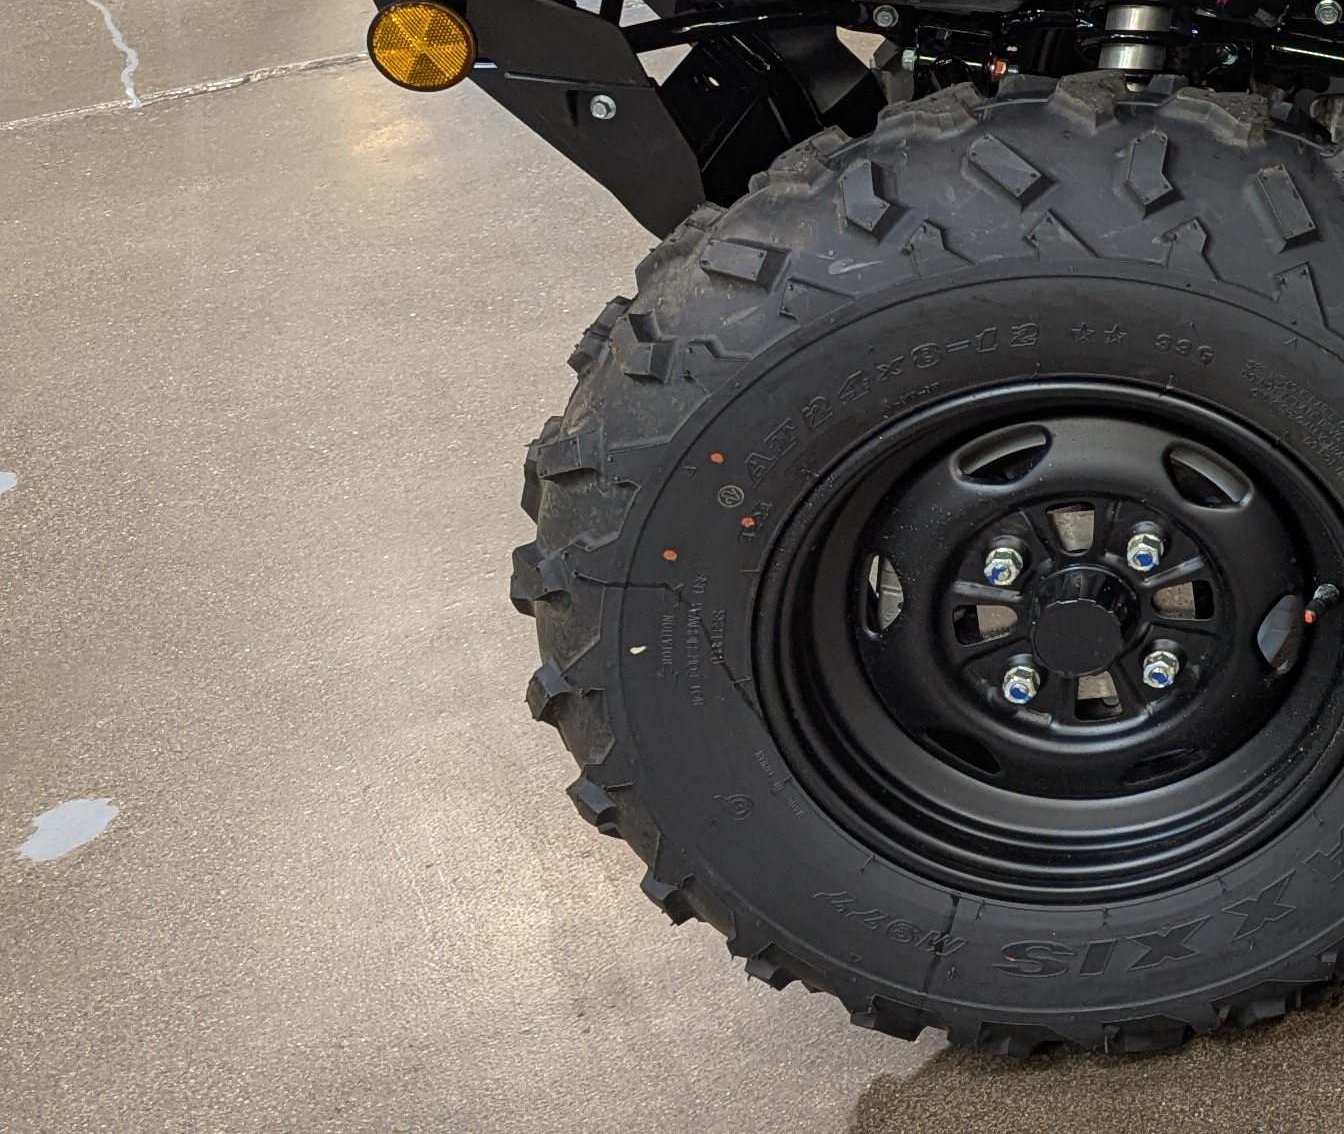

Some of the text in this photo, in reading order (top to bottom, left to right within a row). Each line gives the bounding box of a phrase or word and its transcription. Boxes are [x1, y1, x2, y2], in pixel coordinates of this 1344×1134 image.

[661, 614, 674, 664] ROTATION
[689, 683, 705, 706] NOT
[812, 890, 970, 961] M977
